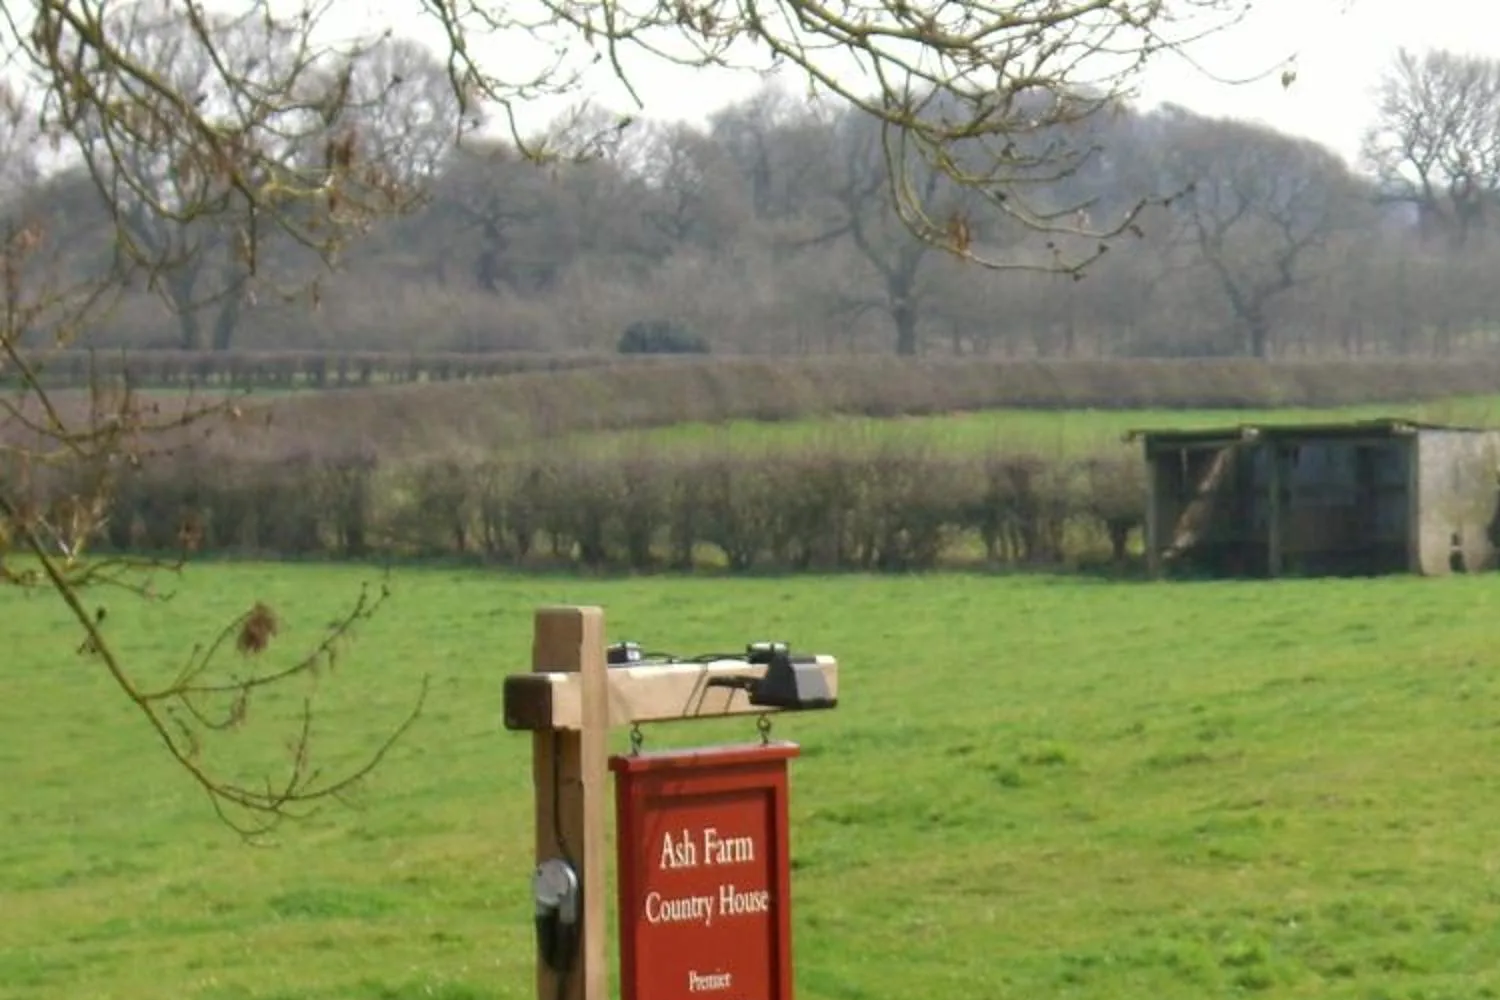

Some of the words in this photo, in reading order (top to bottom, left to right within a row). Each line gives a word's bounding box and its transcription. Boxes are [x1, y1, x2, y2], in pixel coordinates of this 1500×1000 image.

[660, 829, 697, 869] Ash
[703, 827, 753, 865] Farm
[645, 891, 713, 926] Country
[719, 884, 769, 916] House
[689, 968, 731, 992] Premier
